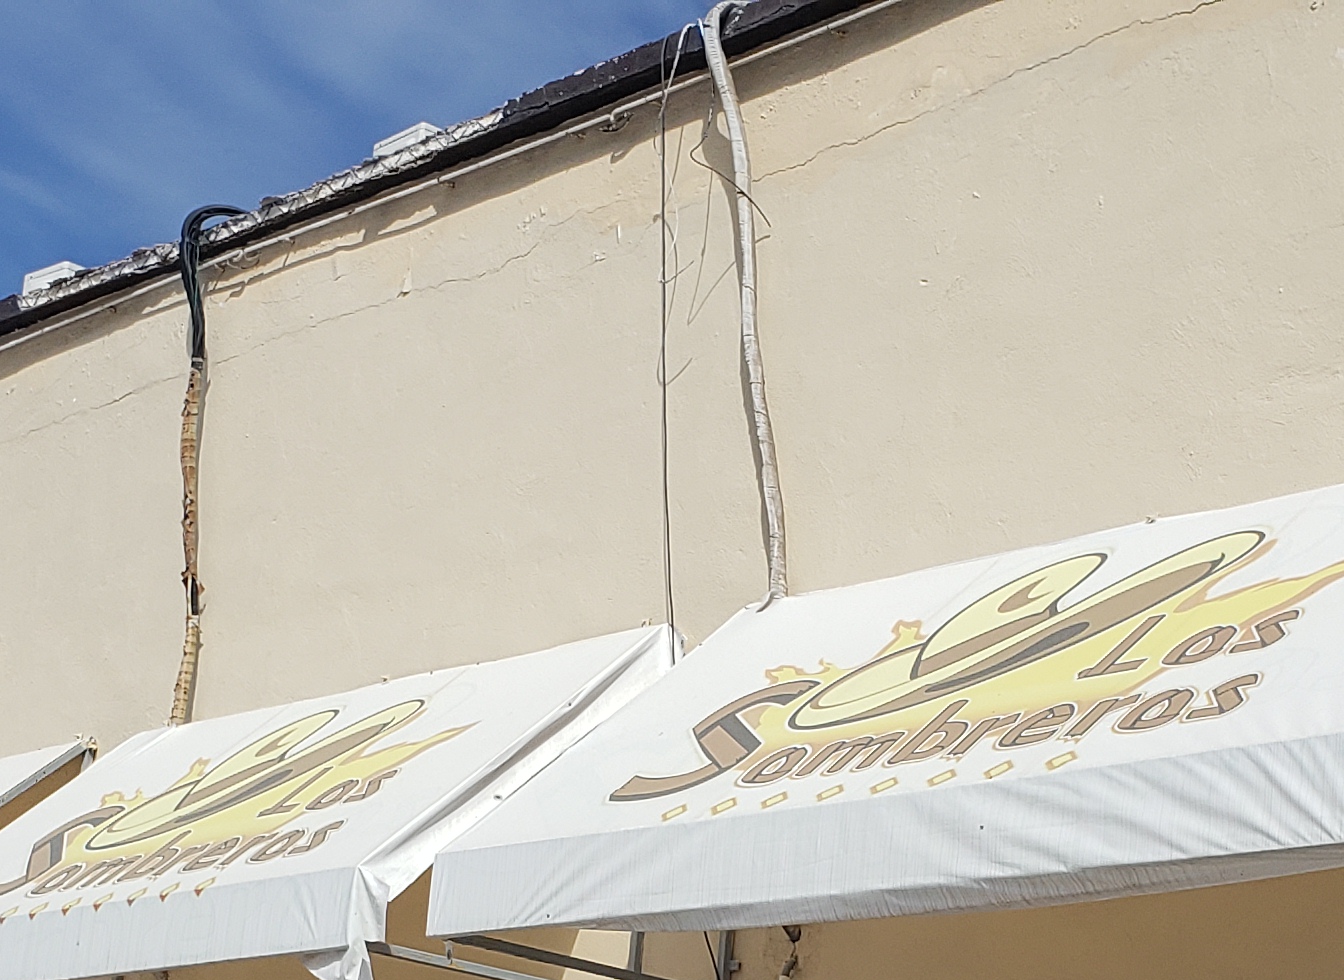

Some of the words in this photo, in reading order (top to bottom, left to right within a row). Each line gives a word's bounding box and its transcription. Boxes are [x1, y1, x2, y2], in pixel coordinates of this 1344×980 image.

[1076, 609, 1301, 680] Los
[608, 673, 1261, 802] Sombreros
[258, 767, 399, 818] Los
